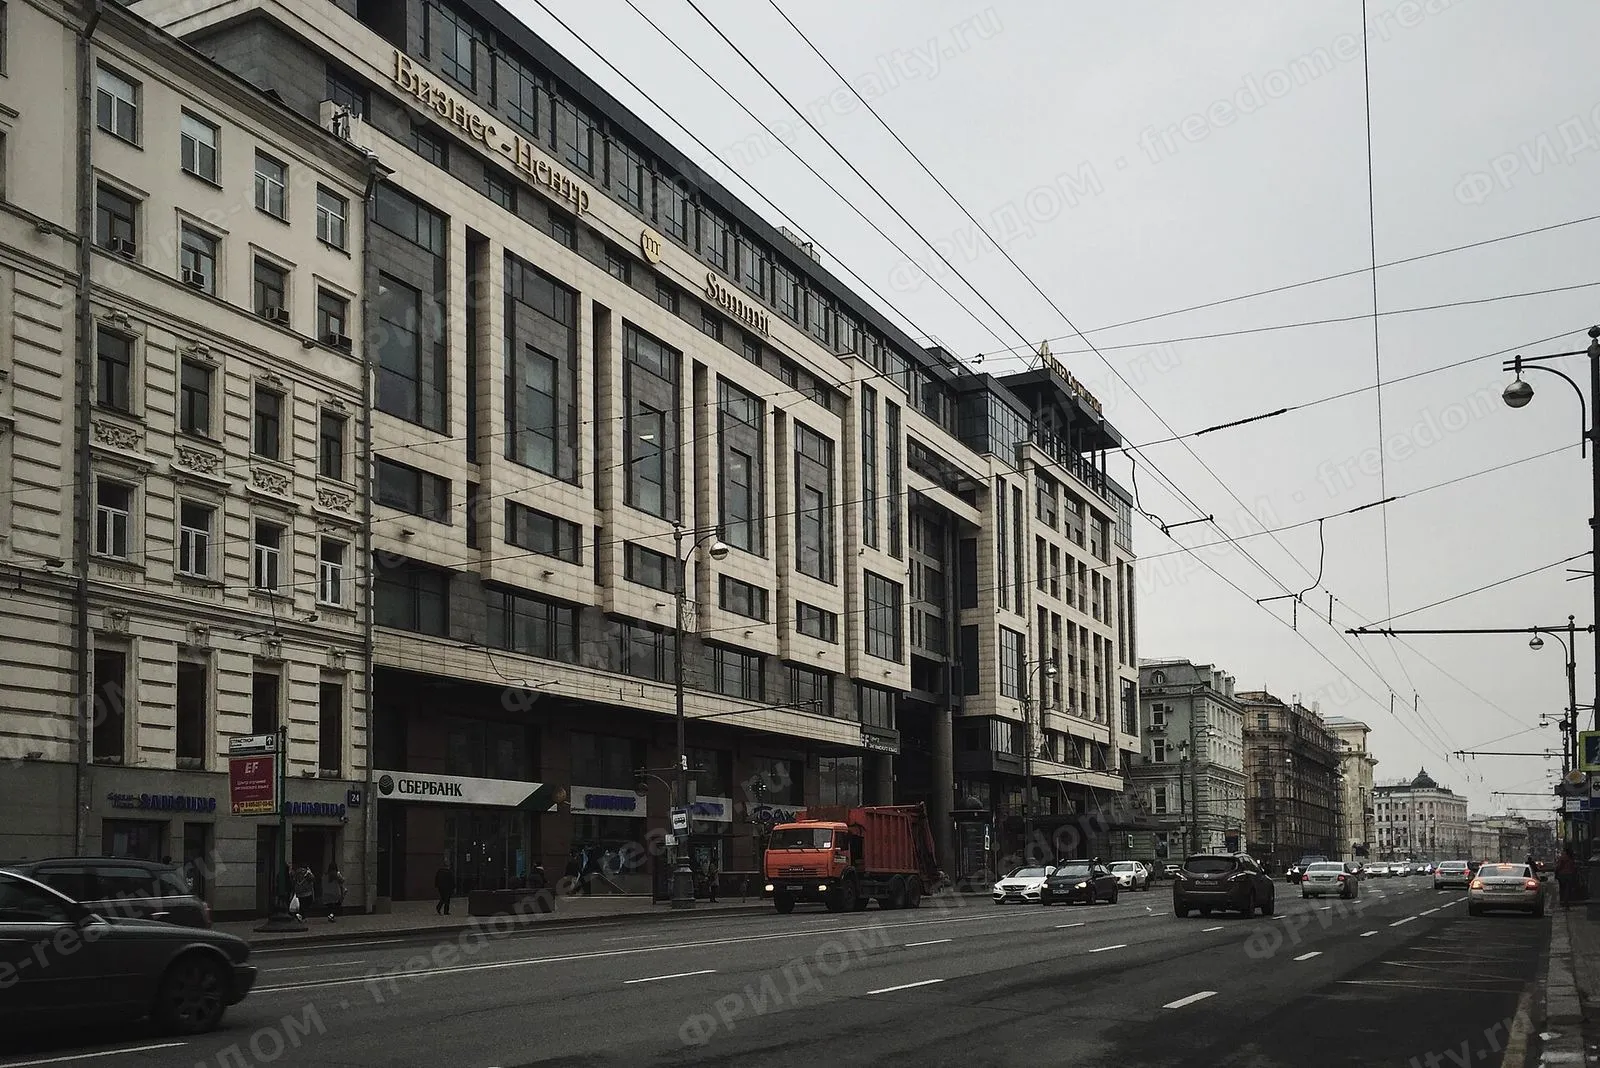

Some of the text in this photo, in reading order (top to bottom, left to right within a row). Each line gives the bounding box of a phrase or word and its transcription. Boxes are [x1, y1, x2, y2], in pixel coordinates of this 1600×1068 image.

[705, 272, 770, 338] Summit
[244, 761, 259, 774] EF
[398, 779, 463, 797] СБЕРБАНК
[351, 793, 360, 803] 24
